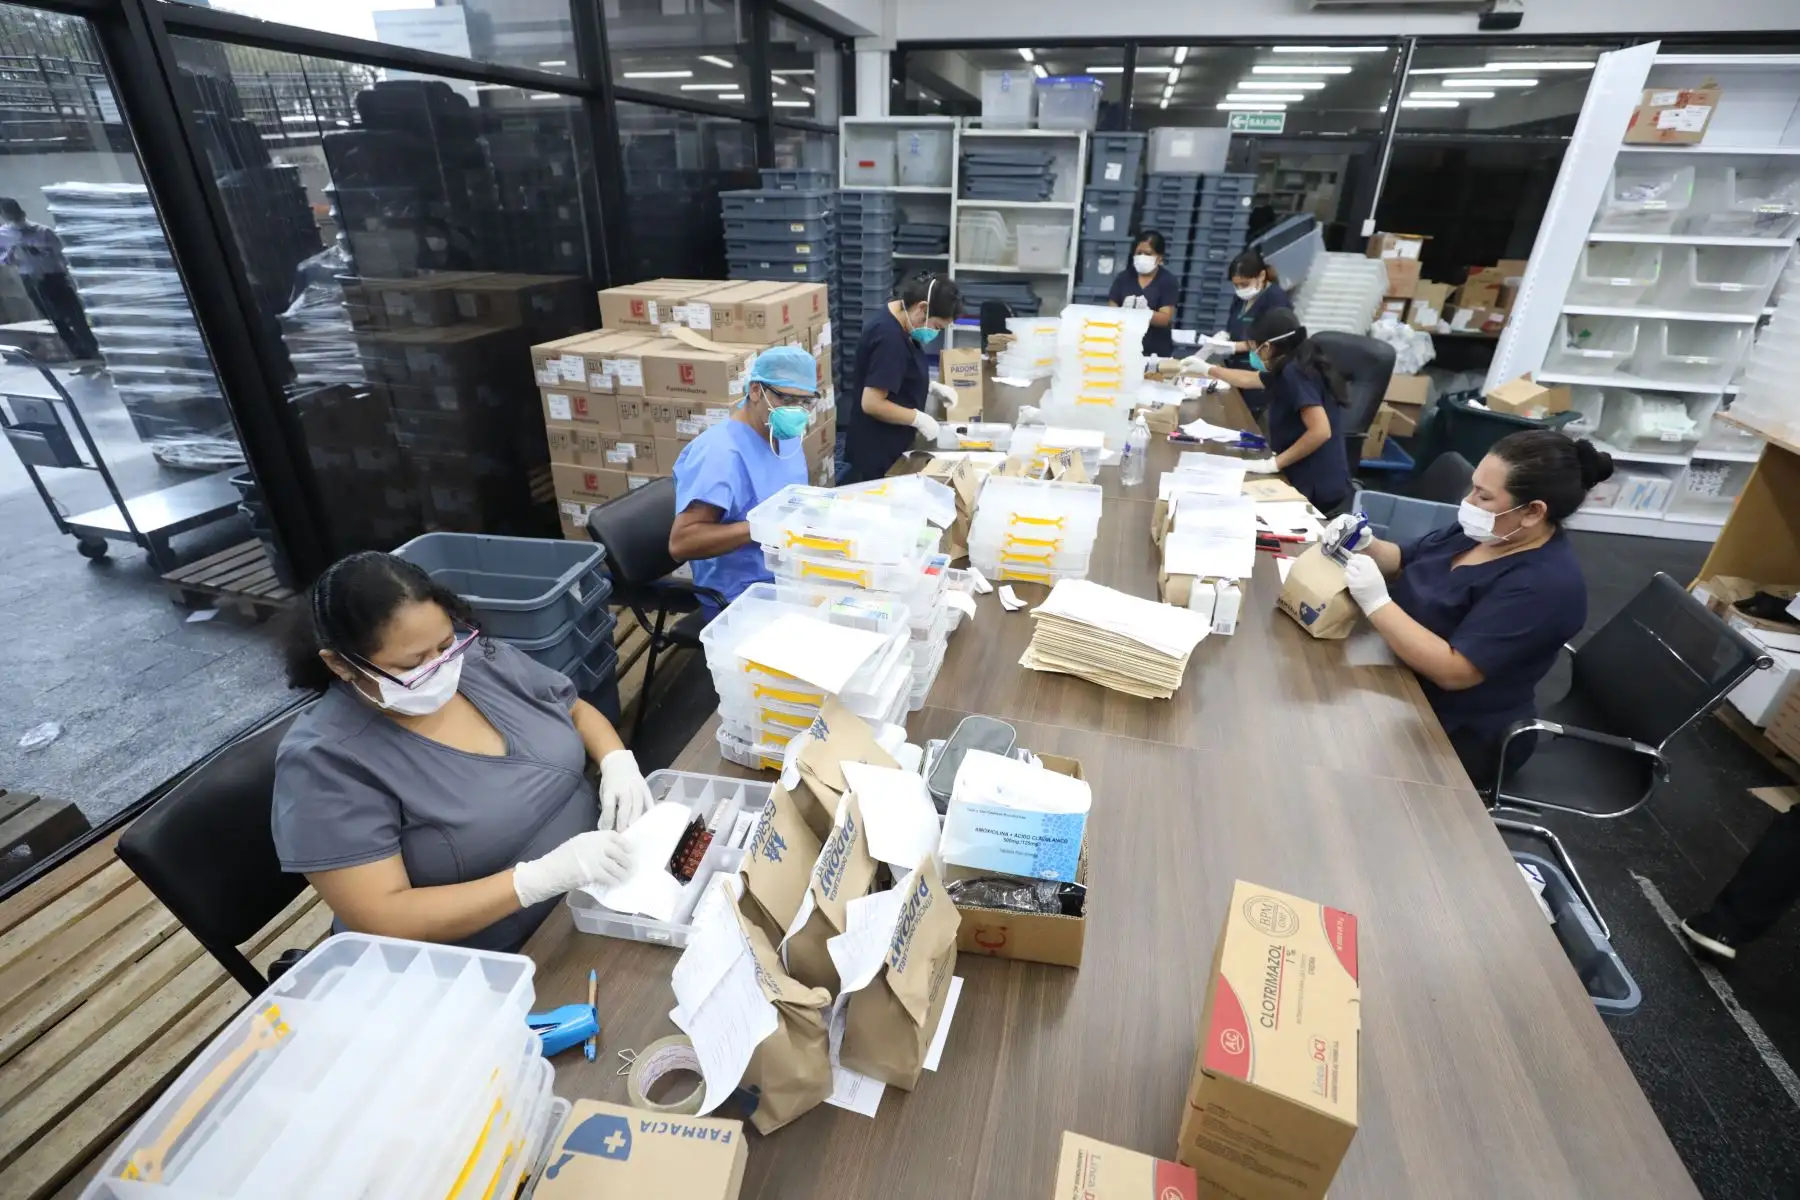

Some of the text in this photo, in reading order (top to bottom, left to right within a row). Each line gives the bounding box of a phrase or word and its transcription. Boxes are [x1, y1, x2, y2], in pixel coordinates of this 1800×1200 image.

[1249, 118, 1281, 126] SALIDA
[950, 365, 979, 374] PADOMI
[1260, 944, 1283, 1029] CLOTRIMAZOL
[1314, 1039, 1326, 1062] DCI
[639, 1119, 733, 1144] FARMACIA
